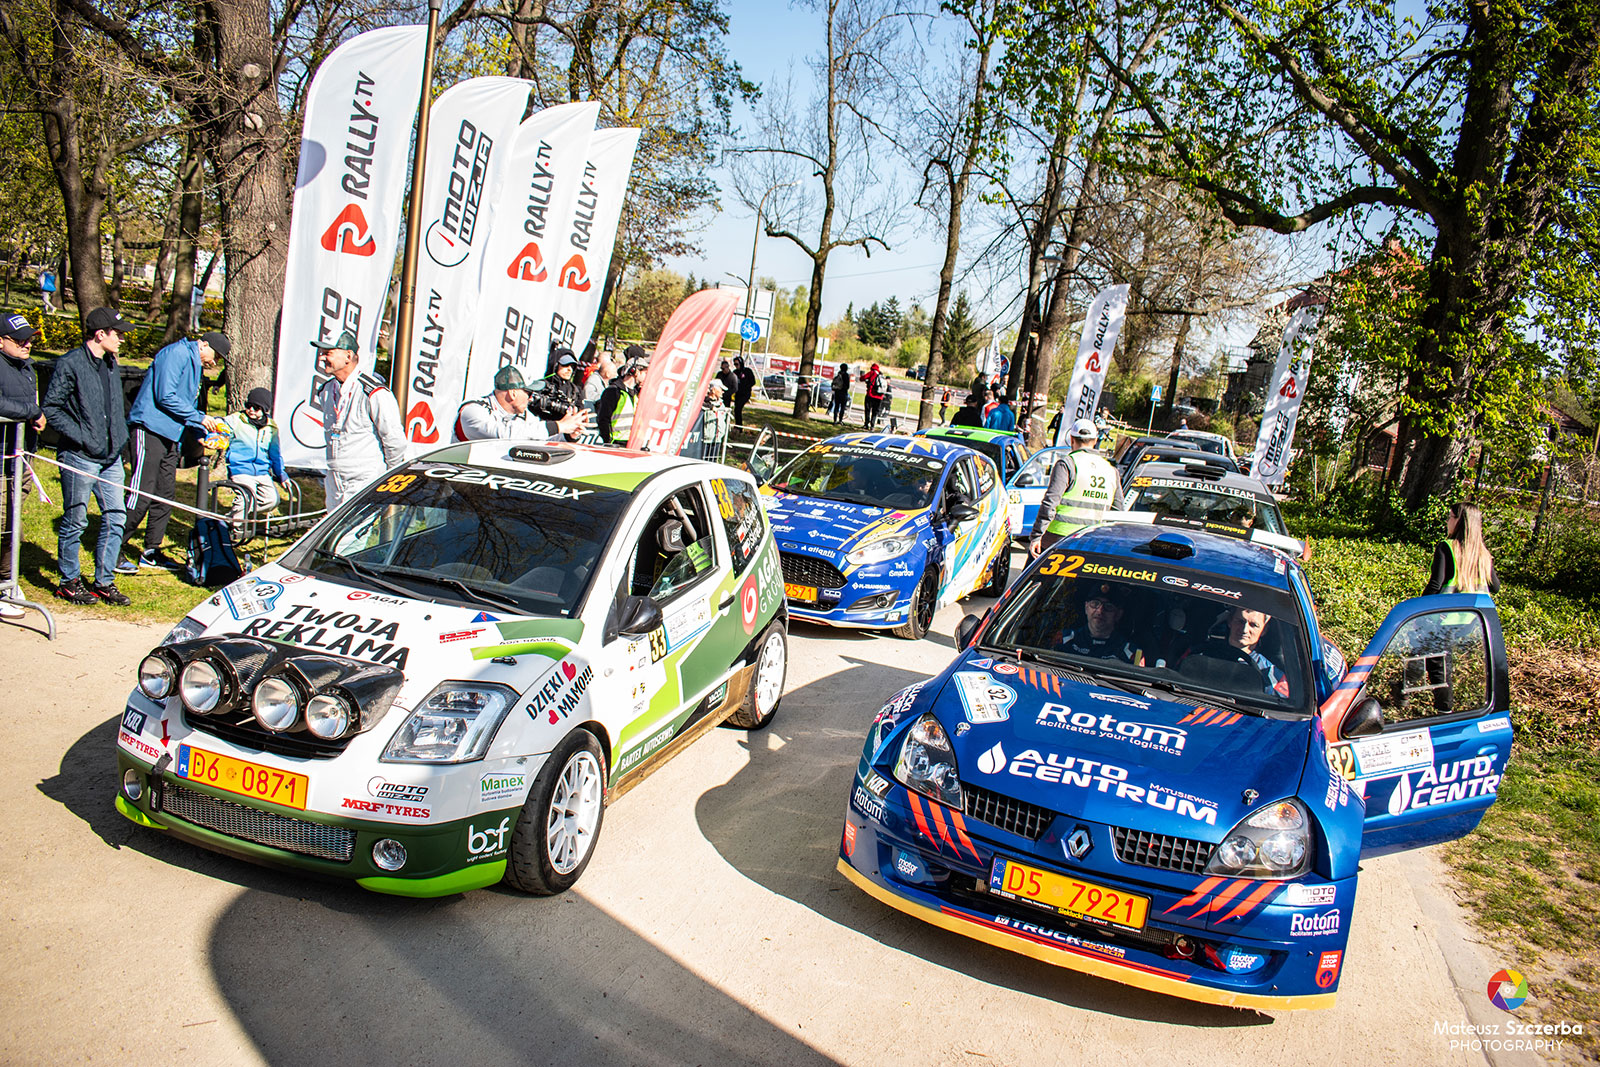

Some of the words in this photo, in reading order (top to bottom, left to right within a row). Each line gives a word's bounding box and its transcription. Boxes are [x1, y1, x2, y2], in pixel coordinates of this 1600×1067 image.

[341, 70, 379, 200] RALLY.TV
[524, 140, 555, 239] RALLY.TV
[570, 160, 598, 251] RALLY.TV
[498, 306, 520, 369] OTO
[1093, 301, 1111, 351] RALLY.TV
[413, 288, 445, 397] RALLY.TV
[1075, 384, 1090, 422] OTO
[809, 445, 833, 454] 34
[833, 445, 923, 464] wertulracing.pl
[1142, 454, 1160, 462] 37
[376, 474, 418, 493] 33
[1082, 489, 1108, 500] MEDIA
[1090, 475, 1106, 489] 32
[1131, 477, 1153, 487] 35
[1151, 479, 1195, 489] OBRZUT
[1196, 482, 1228, 494] RALLY
[1228, 487, 1256, 499] TEAM
[711, 478, 735, 520] 33
[803, 500, 856, 514] wertul
[255, 585, 276, 597] 33
[1039, 553, 1085, 578] 32
[1082, 563, 1158, 583] Sieklucki
[1190, 582, 1243, 599] sport
[368, 595, 409, 606] AGAT
[284, 604, 400, 641] TWOJA
[241, 618, 410, 671] REKLAMA
[650, 628, 667, 662] 33
[525, 671, 565, 720] DZIĘKI
[558, 665, 594, 719] MAMO!!!
[988, 688, 1007, 701] 32
[1035, 718, 1096, 736] facilitates
[1099, 730, 1127, 742] your
[1129, 736, 1182, 756] logistics
[1037, 702, 1188, 750] Rotom
[136, 740, 160, 759] TYRES
[1013, 749, 1129, 781] AUTO
[1328, 746, 1356, 780] 32
[180, 764, 188, 773] PL
[193, 752, 219, 782] D6
[242, 766, 297, 803] 0871
[481, 776, 524, 792] Manex
[1417, 756, 1493, 788] AUTO
[854, 786, 883, 819] Rotom
[1009, 761, 1218, 826] CENTRUM
[1149, 782, 1219, 808] MATUSIEWICZ
[1411, 774, 1501, 809] CENTR
[341, 798, 385, 813] MRF
[385, 803, 431, 819] TYRES
[993, 876, 1002, 885] PL
[1008, 865, 1043, 896] D5
[1069, 882, 1134, 923] 7921
[1009, 917, 1083, 946] TRUCK
[1291, 909, 1340, 931] Rotom
[1229, 960, 1253, 970] sport
[1230, 953, 1258, 963] motor
